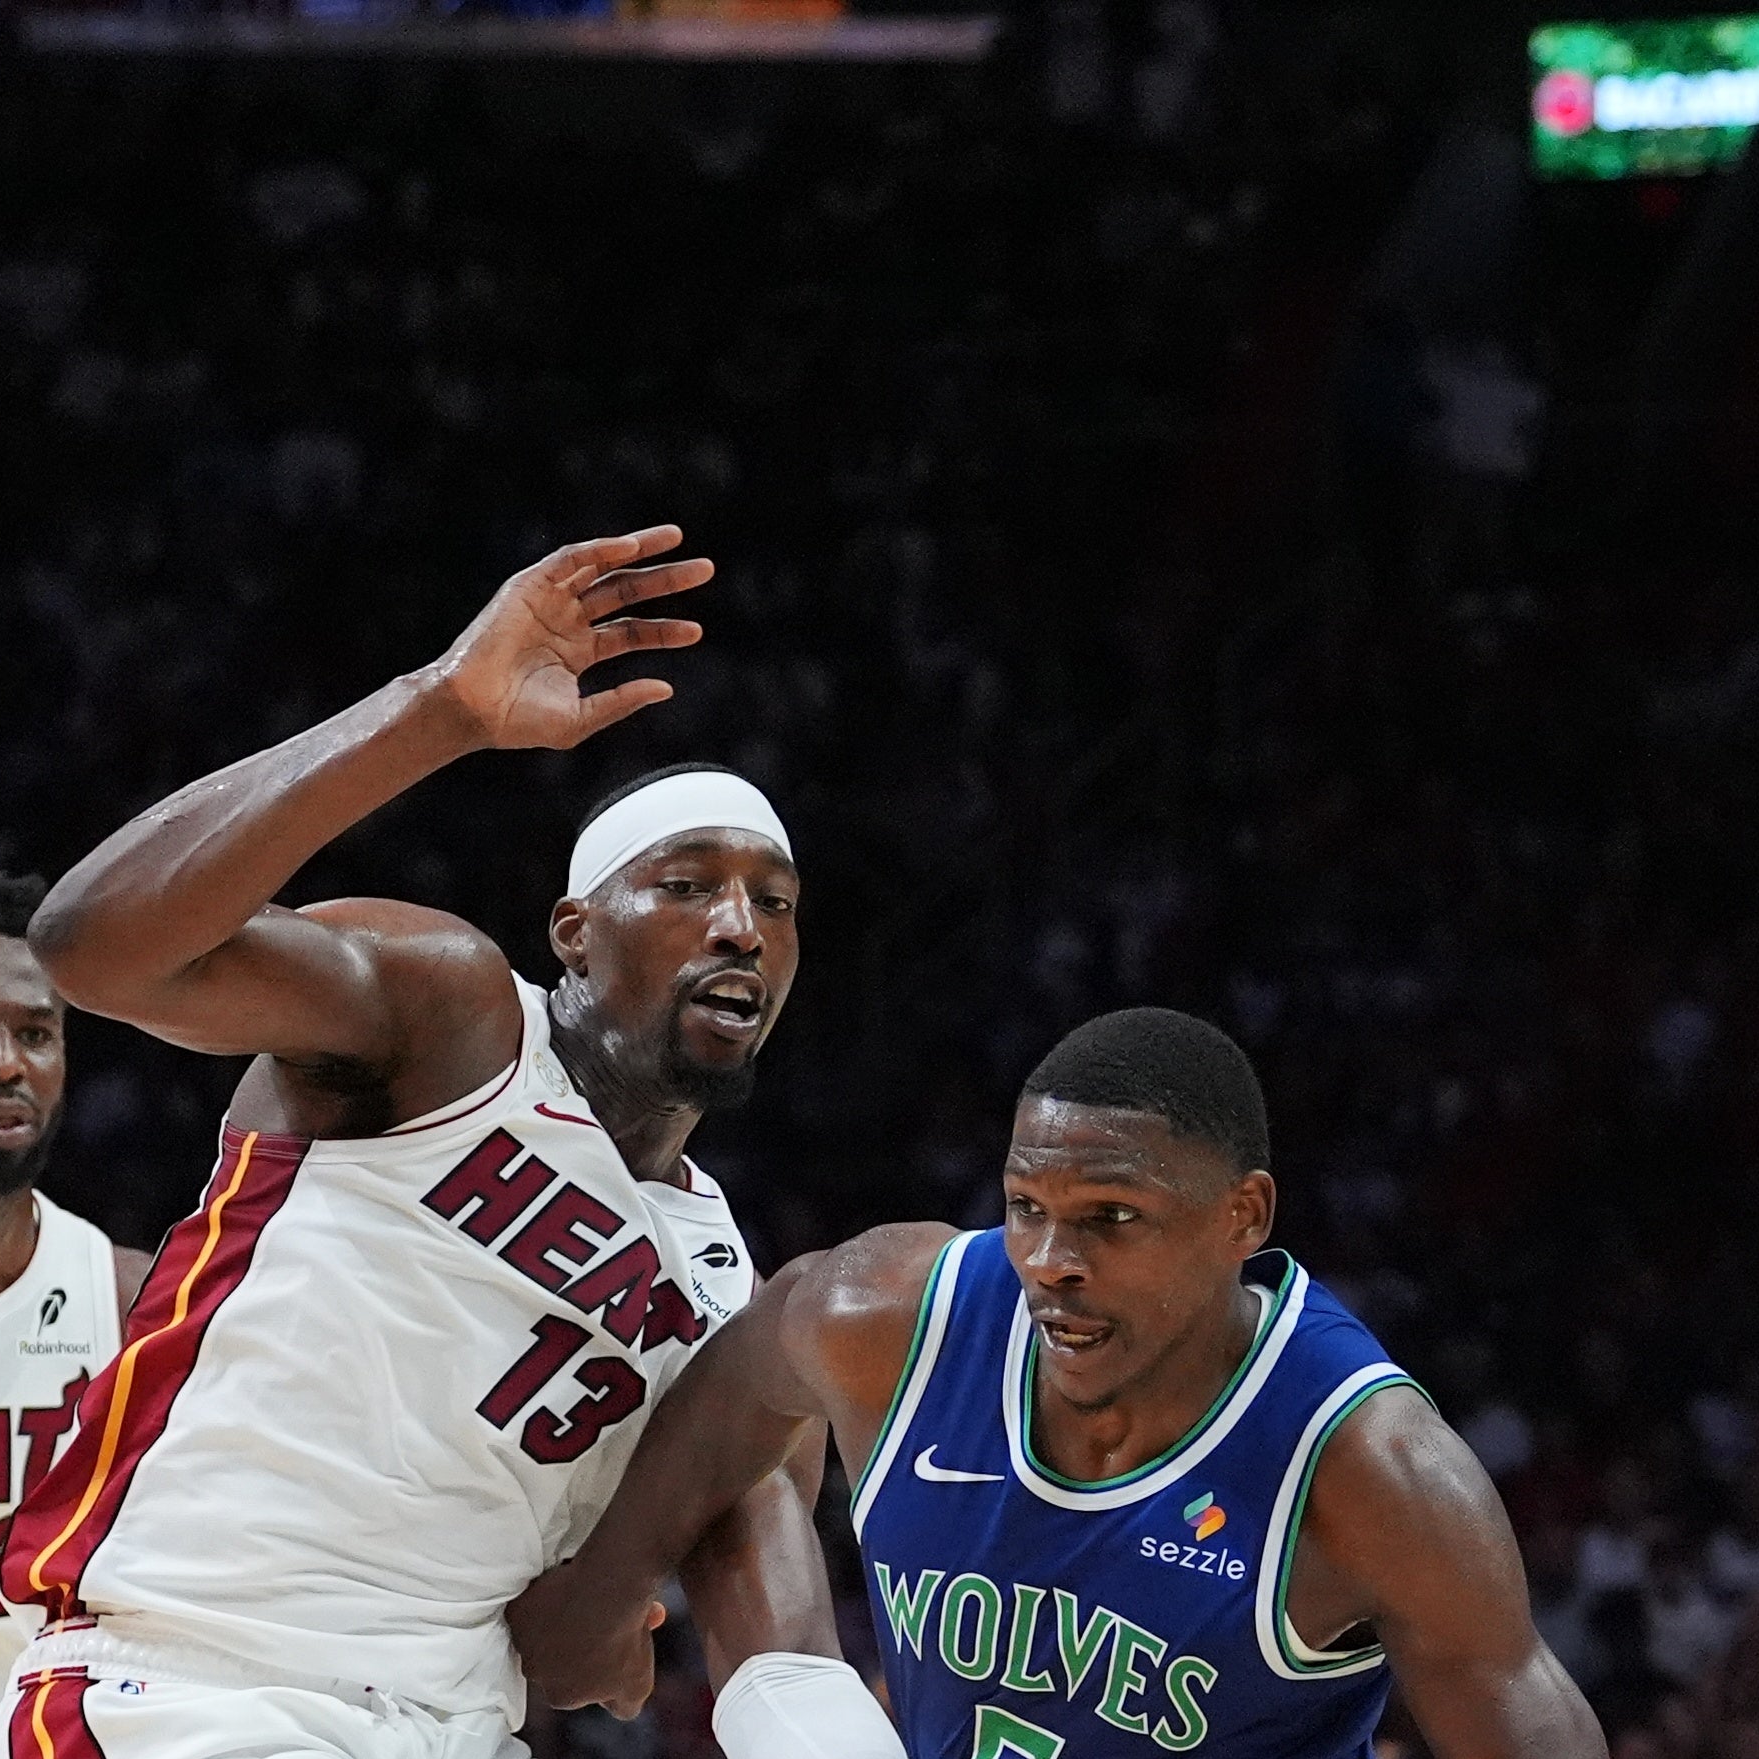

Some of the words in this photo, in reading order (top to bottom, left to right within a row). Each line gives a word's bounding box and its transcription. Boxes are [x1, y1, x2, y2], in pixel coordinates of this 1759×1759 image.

[420, 1127, 707, 1354] HEAT
[19, 1340, 90, 1354] Robinhood
[475, 1314, 646, 1466] 13
[1140, 1536, 1246, 1580] sezzle
[874, 1562, 1219, 1751] WOLVES
